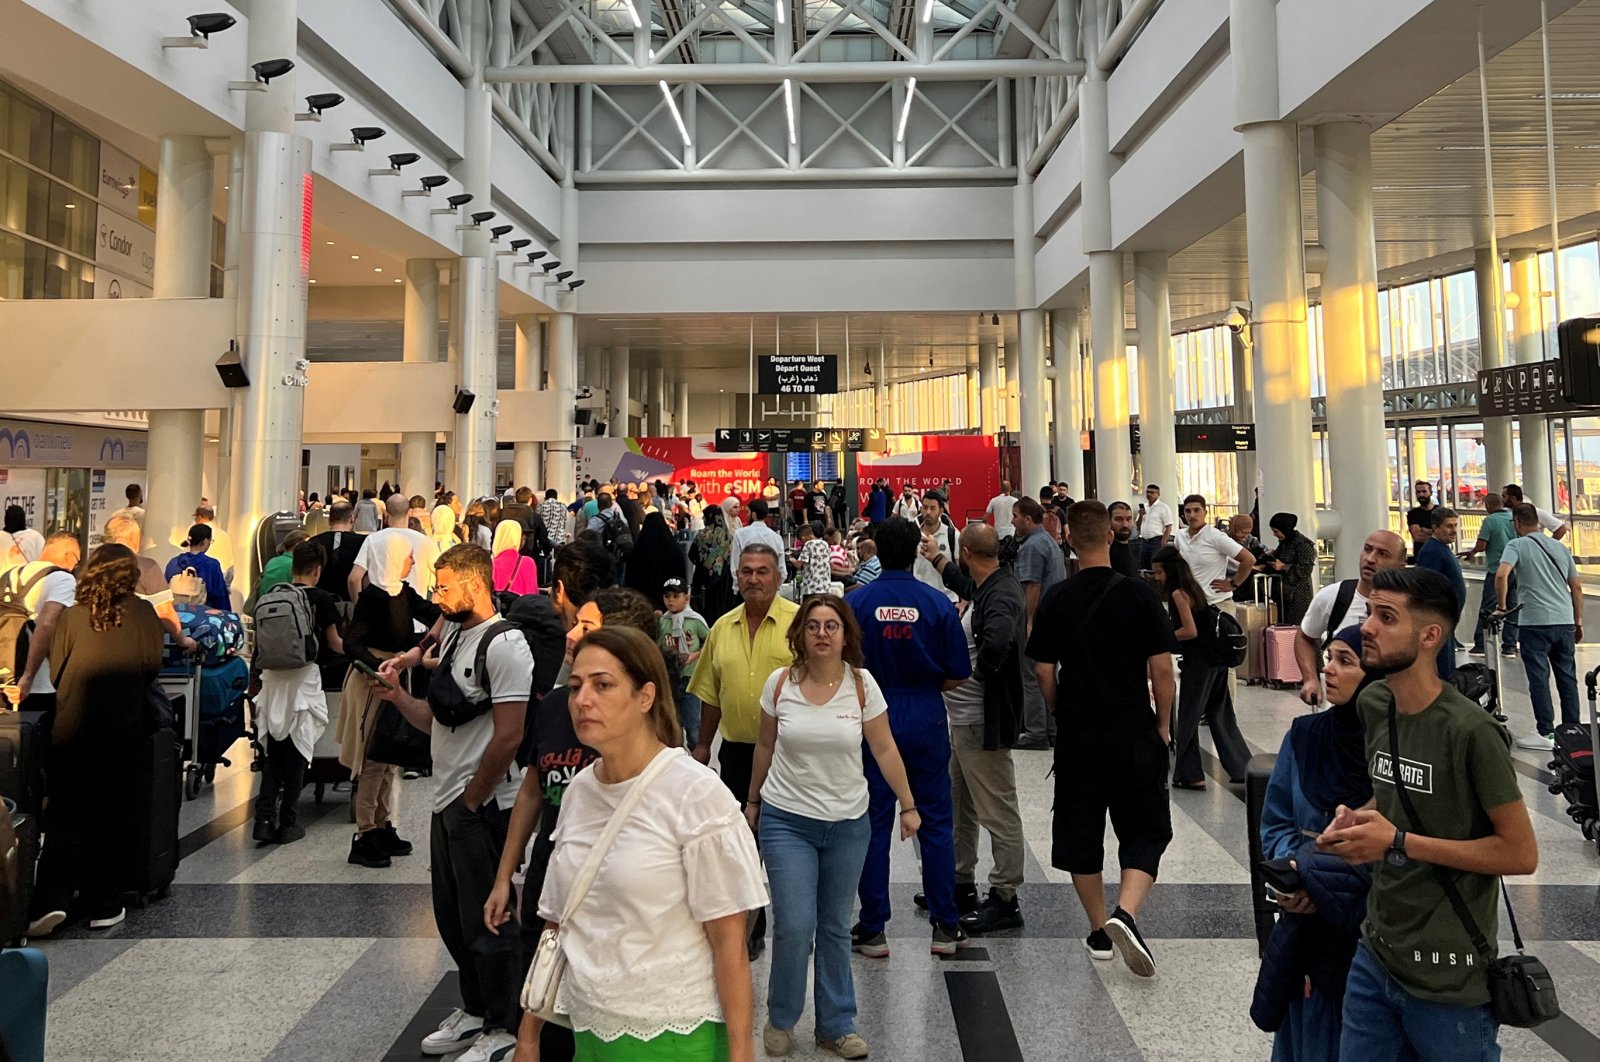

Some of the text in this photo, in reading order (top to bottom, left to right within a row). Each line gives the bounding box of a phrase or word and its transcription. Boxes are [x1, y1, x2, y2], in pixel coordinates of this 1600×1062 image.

[109, 230, 133, 257] Condor
[770, 355, 825, 364] Departure West
[775, 364, 821, 373] Départ Ouest
[780, 385, 816, 393] 46 TO 88
[690, 468, 761, 478] Roam the World
[723, 480, 761, 494] eSIM
[896, 477, 918, 486] THE
[879, 608, 915, 621] MEAS
[1377, 757, 1423, 786] ACCRATE
[1413, 950, 1474, 967] BUSH
